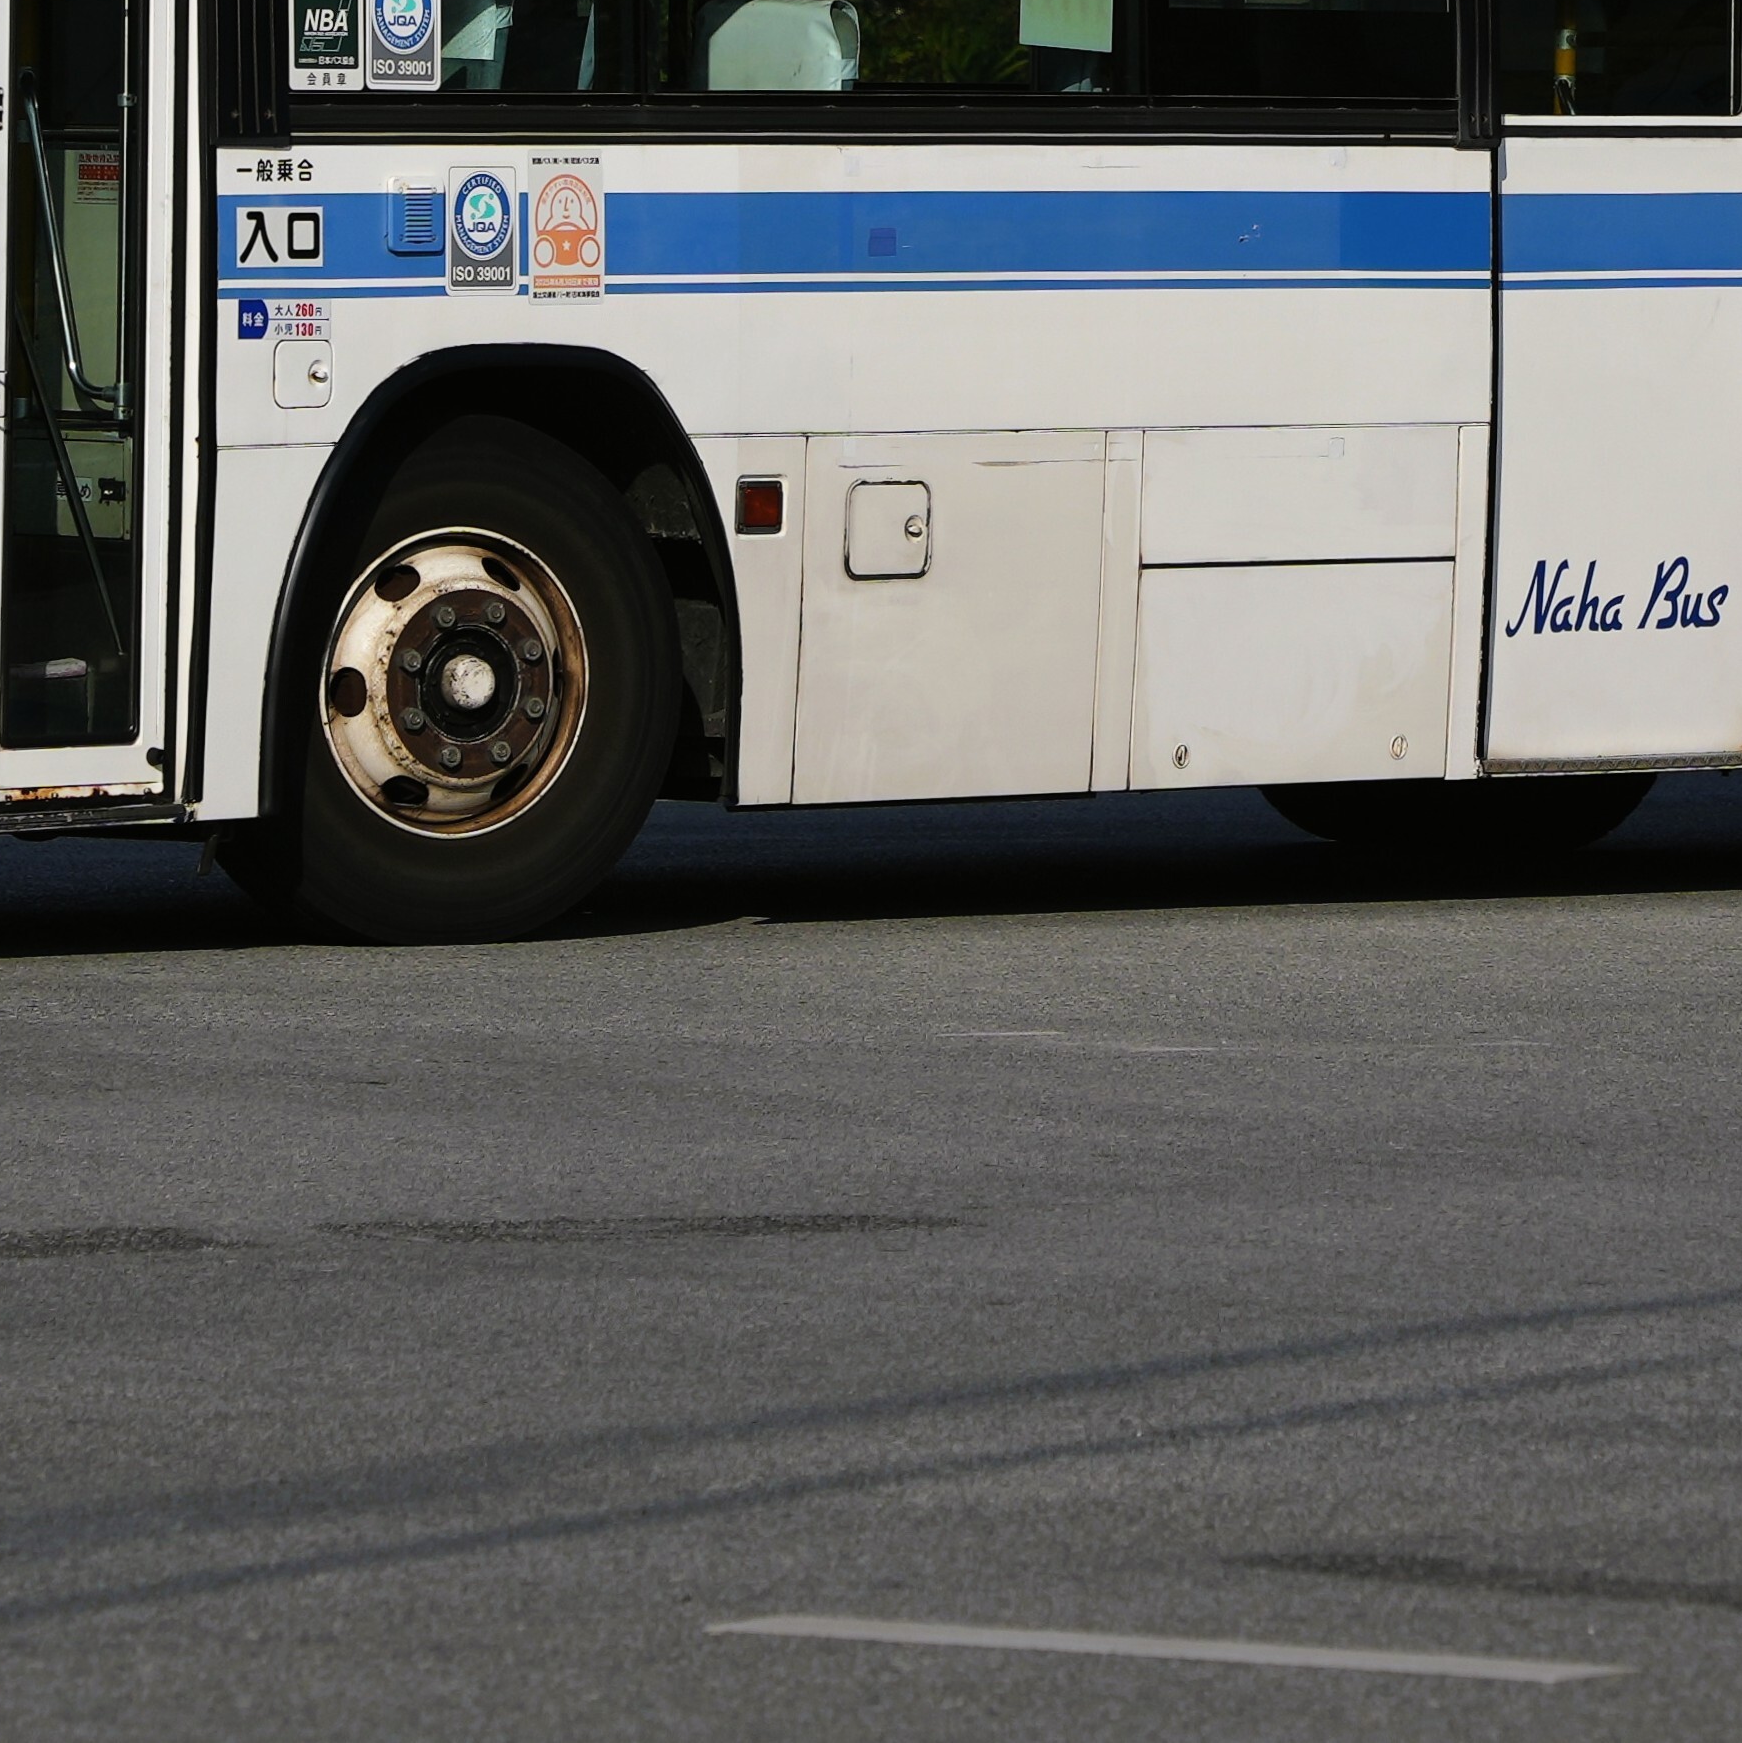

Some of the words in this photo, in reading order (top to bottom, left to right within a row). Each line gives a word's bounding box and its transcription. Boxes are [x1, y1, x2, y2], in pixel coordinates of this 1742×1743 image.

[304, 8, 348, 32] NBA
[375, 8, 414, 48] MANAGEMENT
[415, 9, 430, 44] SYSTEM
[388, 15, 417, 27] JQA
[373, 59, 395, 75] ISO
[398, 60, 432, 76] 39001
[307, 72, 346, 86] 会員章
[236, 158, 314, 182] 一般乗合
[462, 176, 502, 195] CERTIFIED
[455, 214, 493, 253] MANAGEMENT
[493, 214, 509, 249] SYSTEM
[467, 221, 496, 233] JQA
[239, 211, 320, 264] 入口
[452, 265, 475, 281] ISO
[477, 266, 511, 281] 39001
[242, 312, 265, 327] 料金
[1505, 558, 1625, 638] Naha
[1637, 556, 1729, 630] Bus
